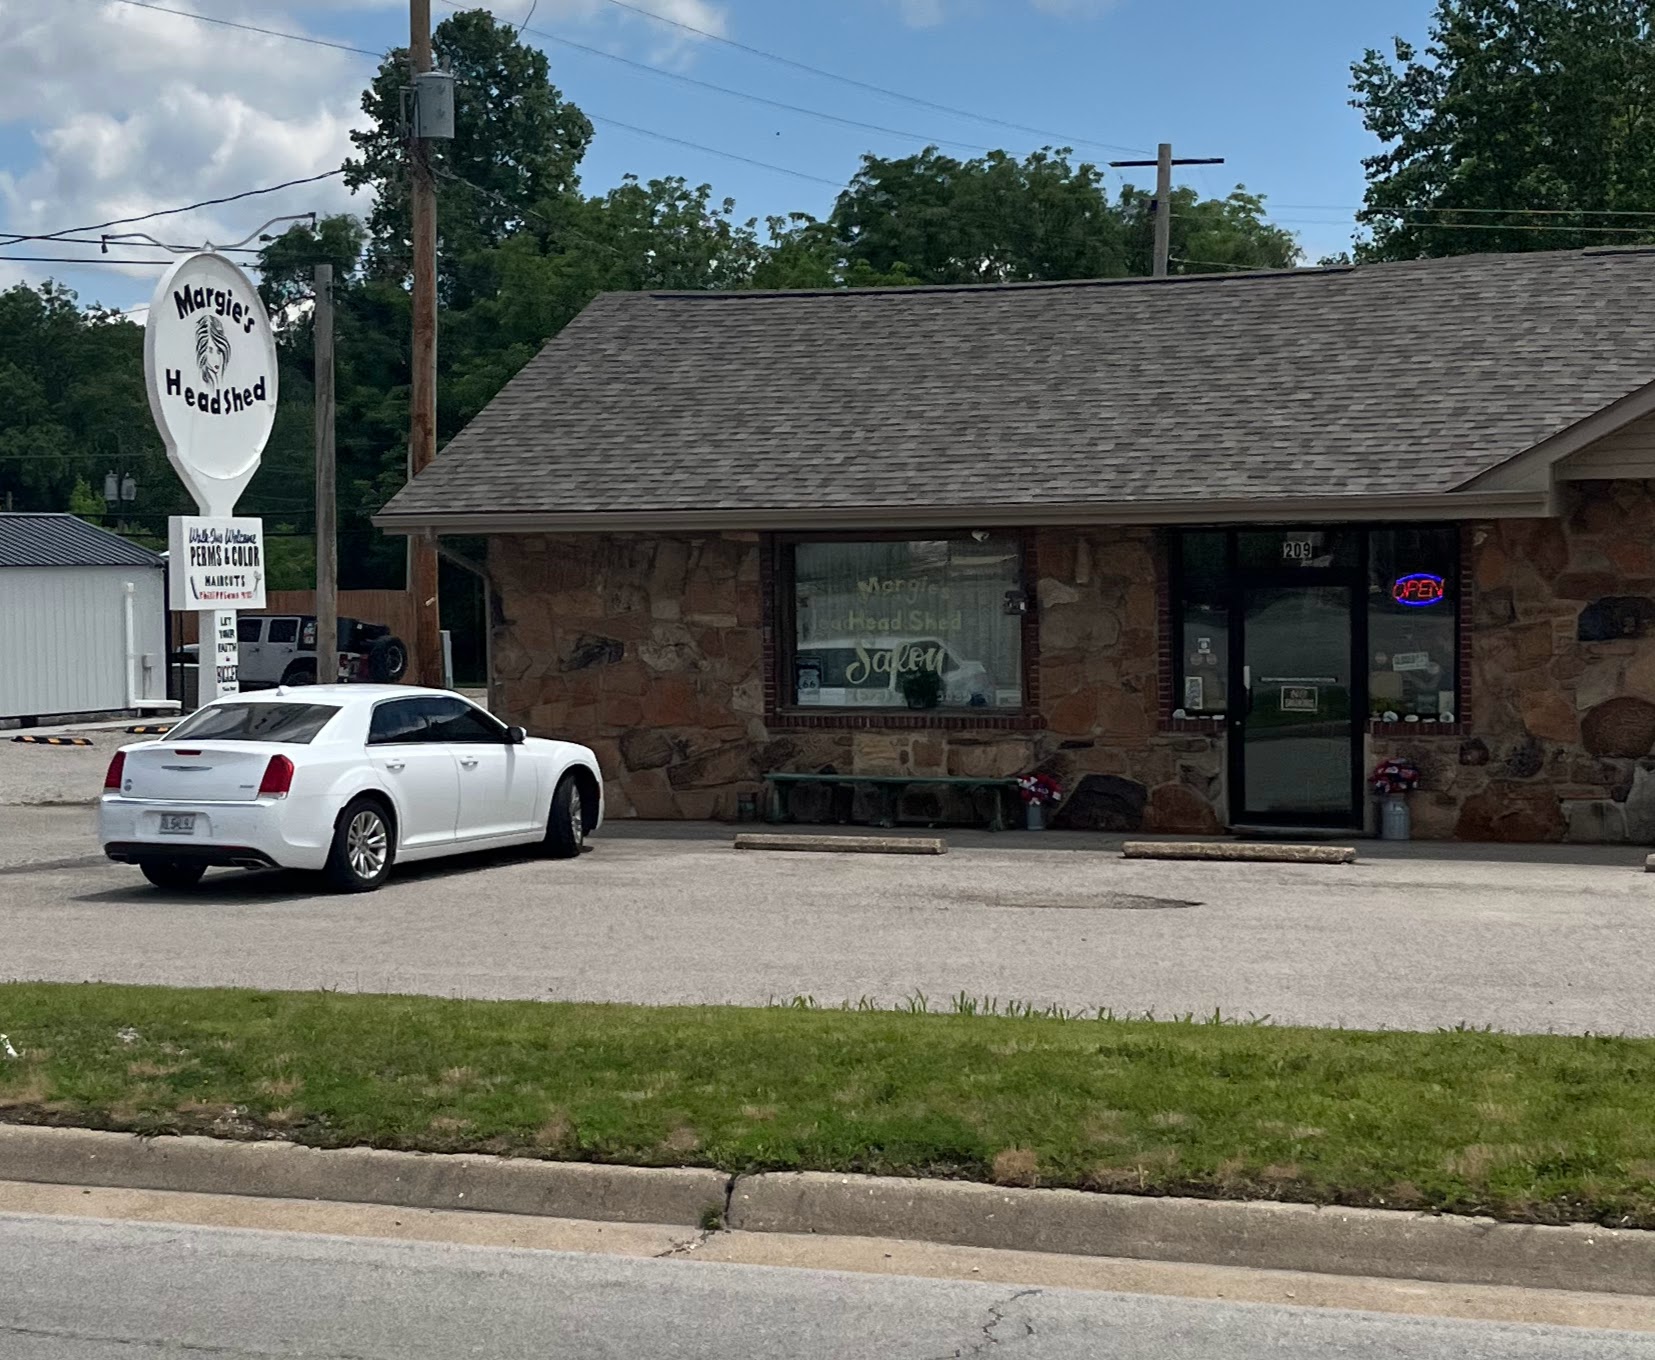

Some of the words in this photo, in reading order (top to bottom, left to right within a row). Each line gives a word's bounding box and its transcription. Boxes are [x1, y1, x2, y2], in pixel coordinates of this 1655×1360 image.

[174, 284, 255, 334] Margie's
[190, 545, 222, 567] PERMS
[224, 547, 230, 565] &
[232, 546, 260, 567] COLOR
[1285, 542, 1311, 558] 209
[205, 575, 245, 587] HAIRCUTS
[1393, 578, 1446, 599] OPEN
[220, 617, 232, 626] LET
[849, 610, 902, 630] Head
[909, 610, 962, 630] Shed
[846, 638, 946, 685] Salon
[802, 680, 816, 689] 66
